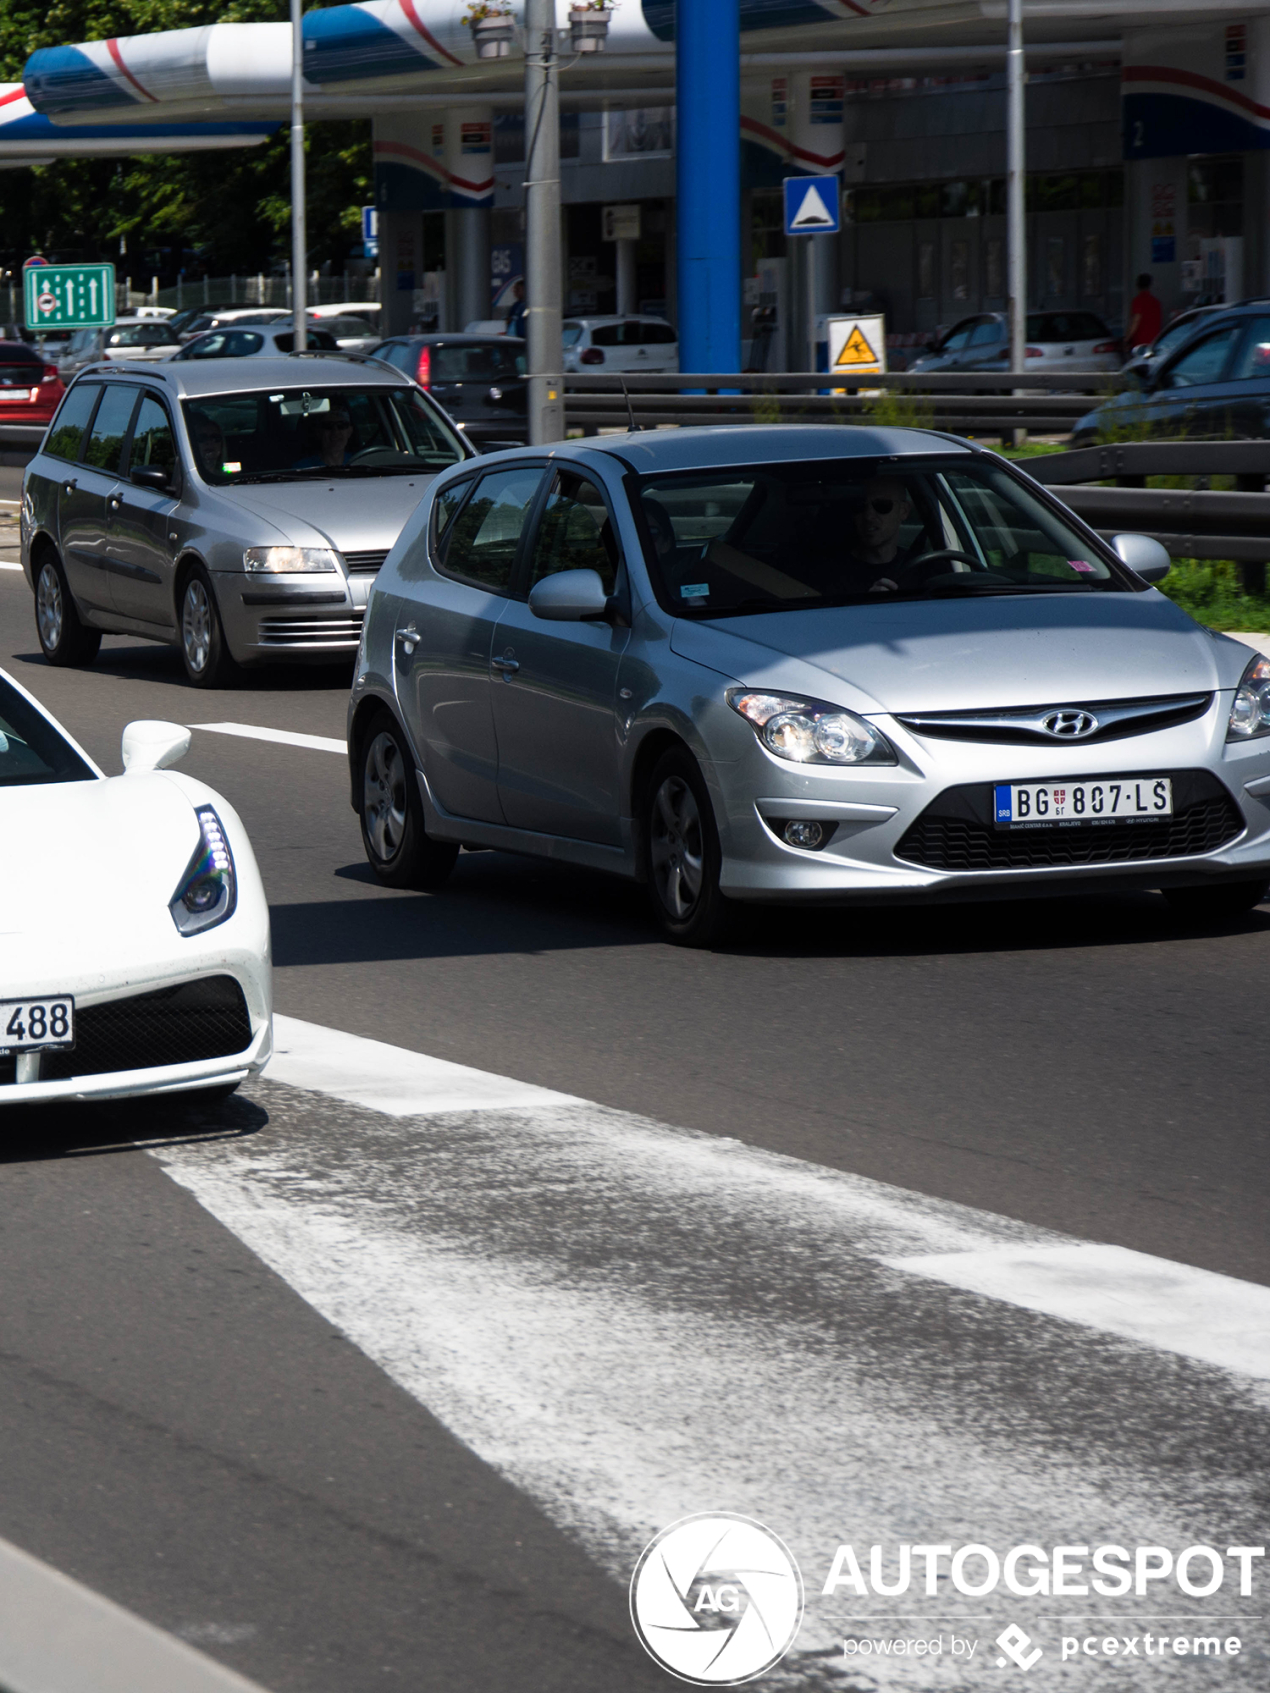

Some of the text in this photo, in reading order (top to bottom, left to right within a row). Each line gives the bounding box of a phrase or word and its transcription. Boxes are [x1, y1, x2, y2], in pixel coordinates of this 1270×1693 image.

[998, 809, 1011, 818] SRB
[1018, 788, 1049, 817] BG
[6, 1003, 69, 1041] 488
